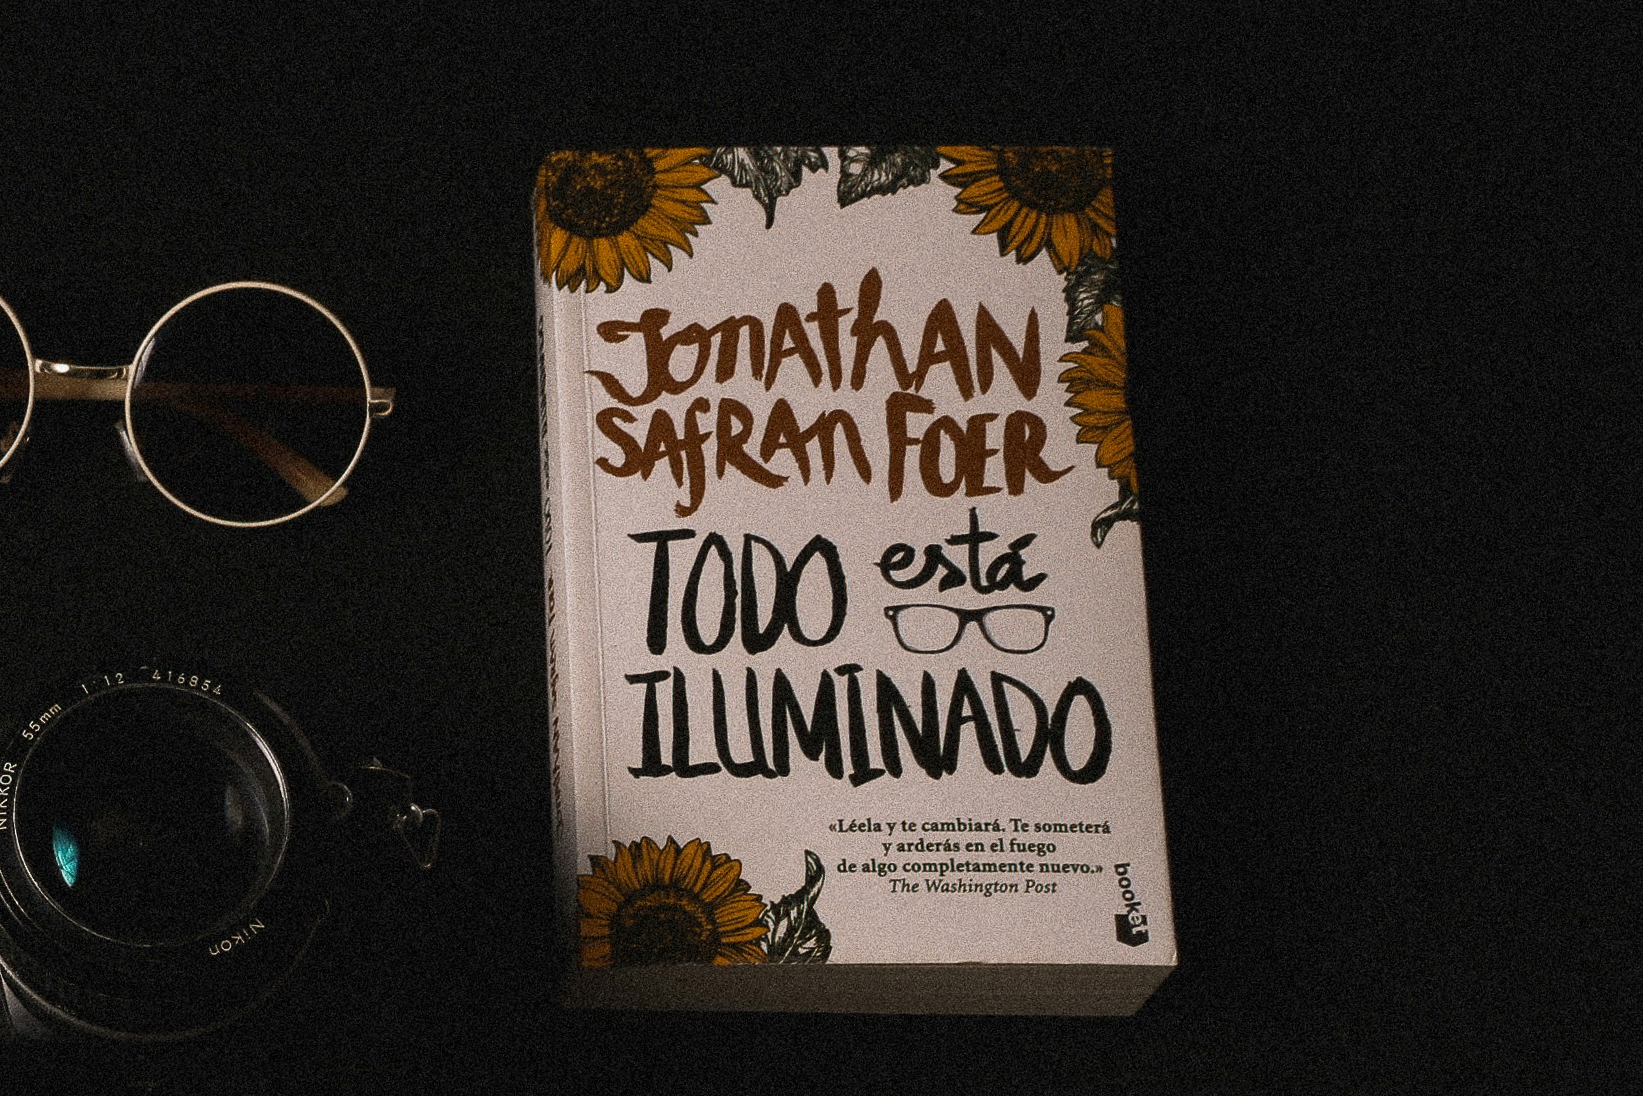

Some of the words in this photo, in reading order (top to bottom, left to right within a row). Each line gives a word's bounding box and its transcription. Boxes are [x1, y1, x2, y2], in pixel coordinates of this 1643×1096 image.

[885, 391, 1076, 502] FOER
[627, 529, 848, 655] TODO
[874, 507, 1048, 595] está
[151, 668, 223, 696] 416854
[21, 704, 62, 741] 55mm
[625, 663, 1113, 785] ILUMINADO
[828, 817, 882, 834] «Léela
[886, 822, 898, 836] y
[901, 819, 917, 833] te
[921, 817, 1006, 833] cambiará.
[1010, 818, 1030, 833] Te
[1034, 820, 1112, 834] someterá
[882, 842, 893, 856] y
[896, 837, 961, 852] arderás
[965, 842, 986, 853] en
[990, 838, 1005, 853] el
[1009, 838, 1057, 857] fuego
[837, 859, 857, 873] de
[861, 858, 898, 877] algo
[902, 858, 1035, 877] completamente
[1039, 862, 1104, 874] nuevo.»
[889, 878, 920, 894] The
[925, 878, 1019, 898] Washington
[1024, 879, 1058, 894] Post
[1114, 862, 1148, 934] booket
[208, 918, 266, 956] Nikon
